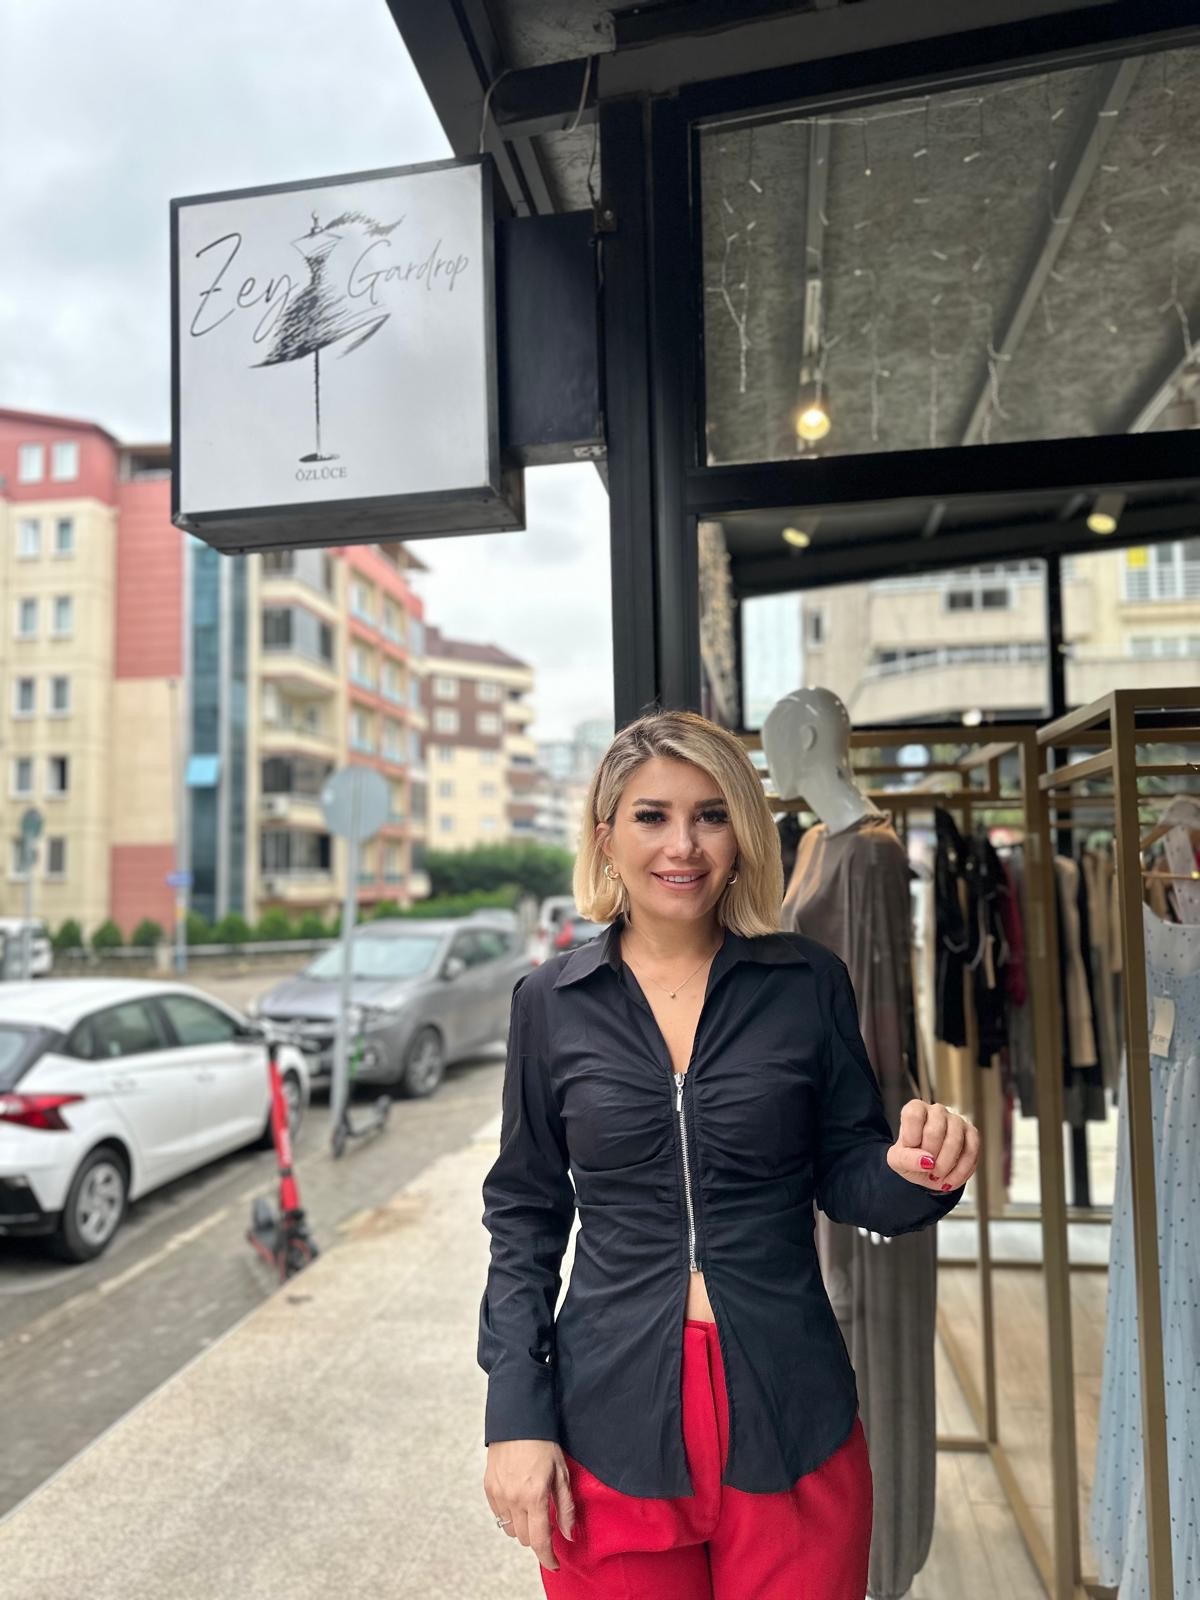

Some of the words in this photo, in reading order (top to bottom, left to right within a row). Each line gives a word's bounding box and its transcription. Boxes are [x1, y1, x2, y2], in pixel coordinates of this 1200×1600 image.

[190, 232, 299, 343] Zey
[347, 239, 469, 305] Gardrop
[295, 466, 348, 481] ÖZLÜCE
